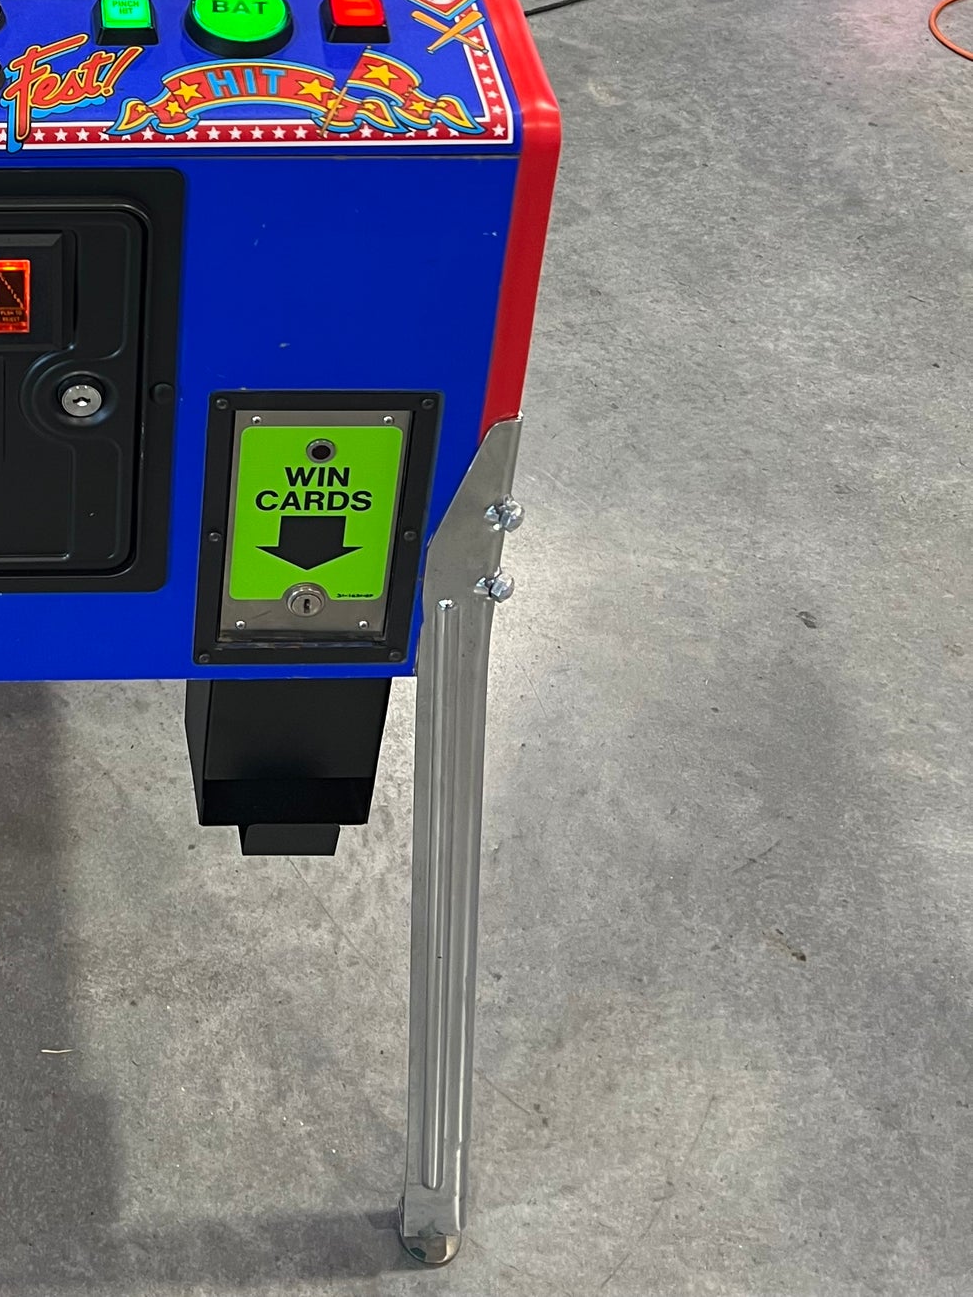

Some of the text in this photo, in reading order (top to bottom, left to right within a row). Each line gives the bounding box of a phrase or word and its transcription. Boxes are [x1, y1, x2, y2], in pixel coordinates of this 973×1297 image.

[112, 0, 140, 8] PINCH
[119, 7, 133, 15] HIT
[211, 0, 268, 16] BAT
[1, 33, 145, 150] Fest!
[204, 67, 291, 99] HIT
[284, 466, 350, 487] WIN
[255, 490, 373, 512] CARDS
